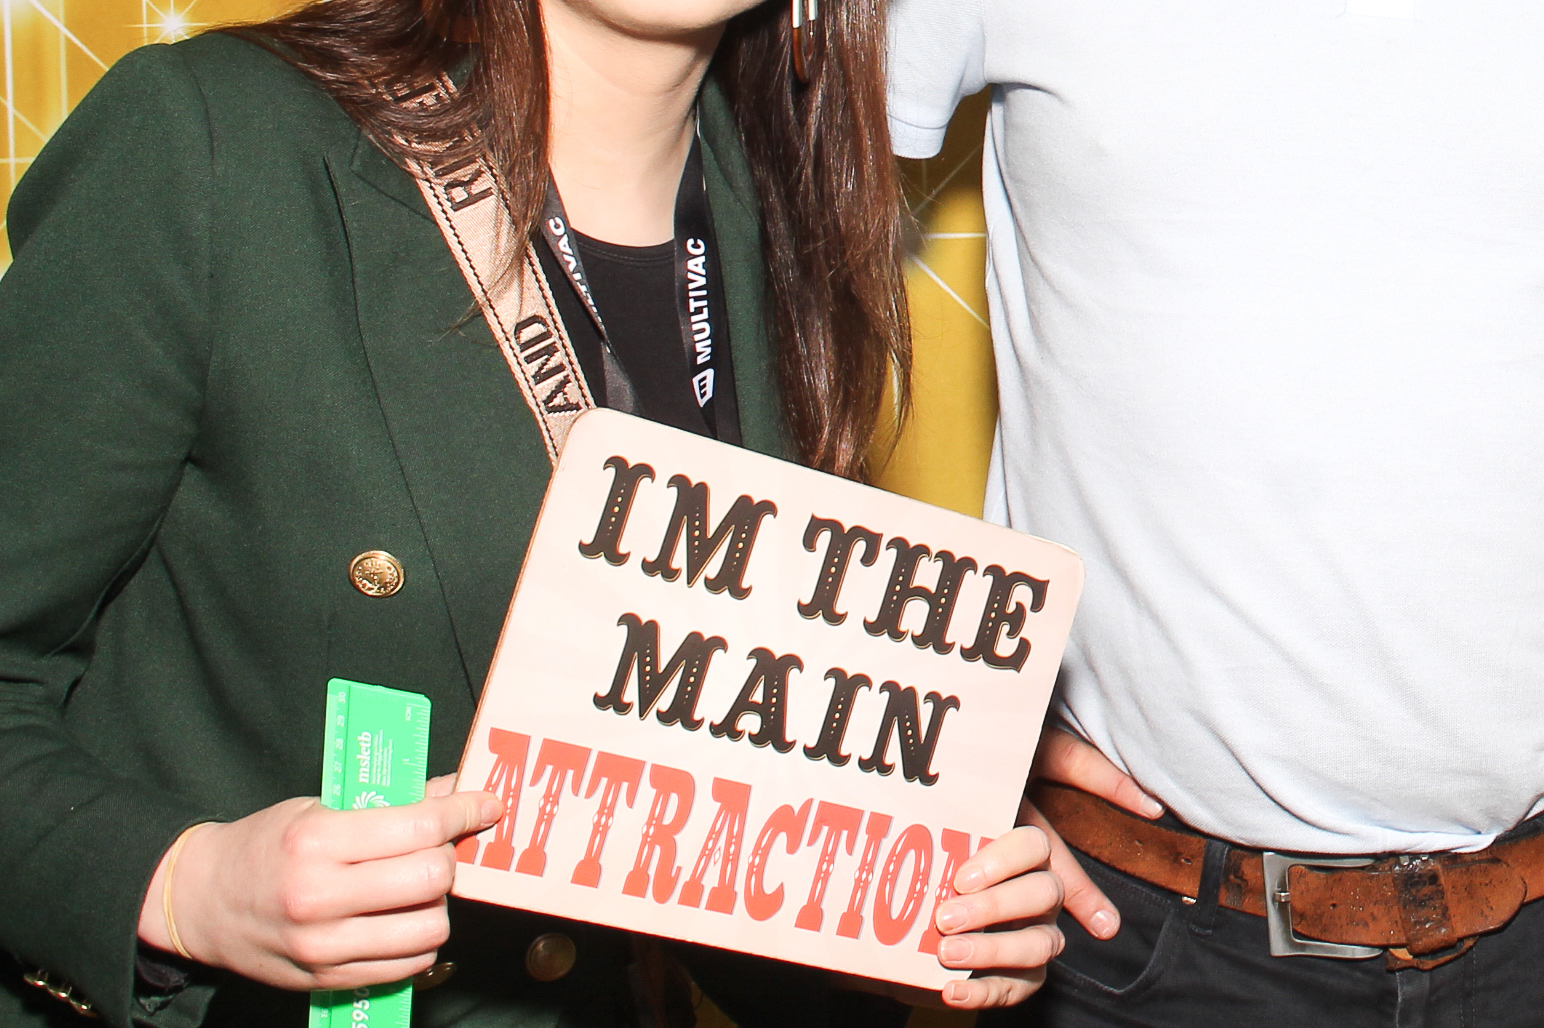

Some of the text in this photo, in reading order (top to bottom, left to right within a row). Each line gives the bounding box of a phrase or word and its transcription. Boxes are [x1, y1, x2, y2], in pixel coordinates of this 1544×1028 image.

[686, 237, 712, 365] MULTIVAC
[578, 455, 1050, 673] IM THE
[338, 691, 347, 704] 30
[592, 612, 960, 787] MAIN
[337, 714, 346, 727] 29
[335, 738, 344, 750] 28
[356, 730, 372, 784] msletb
[334, 761, 343, 773] 27
